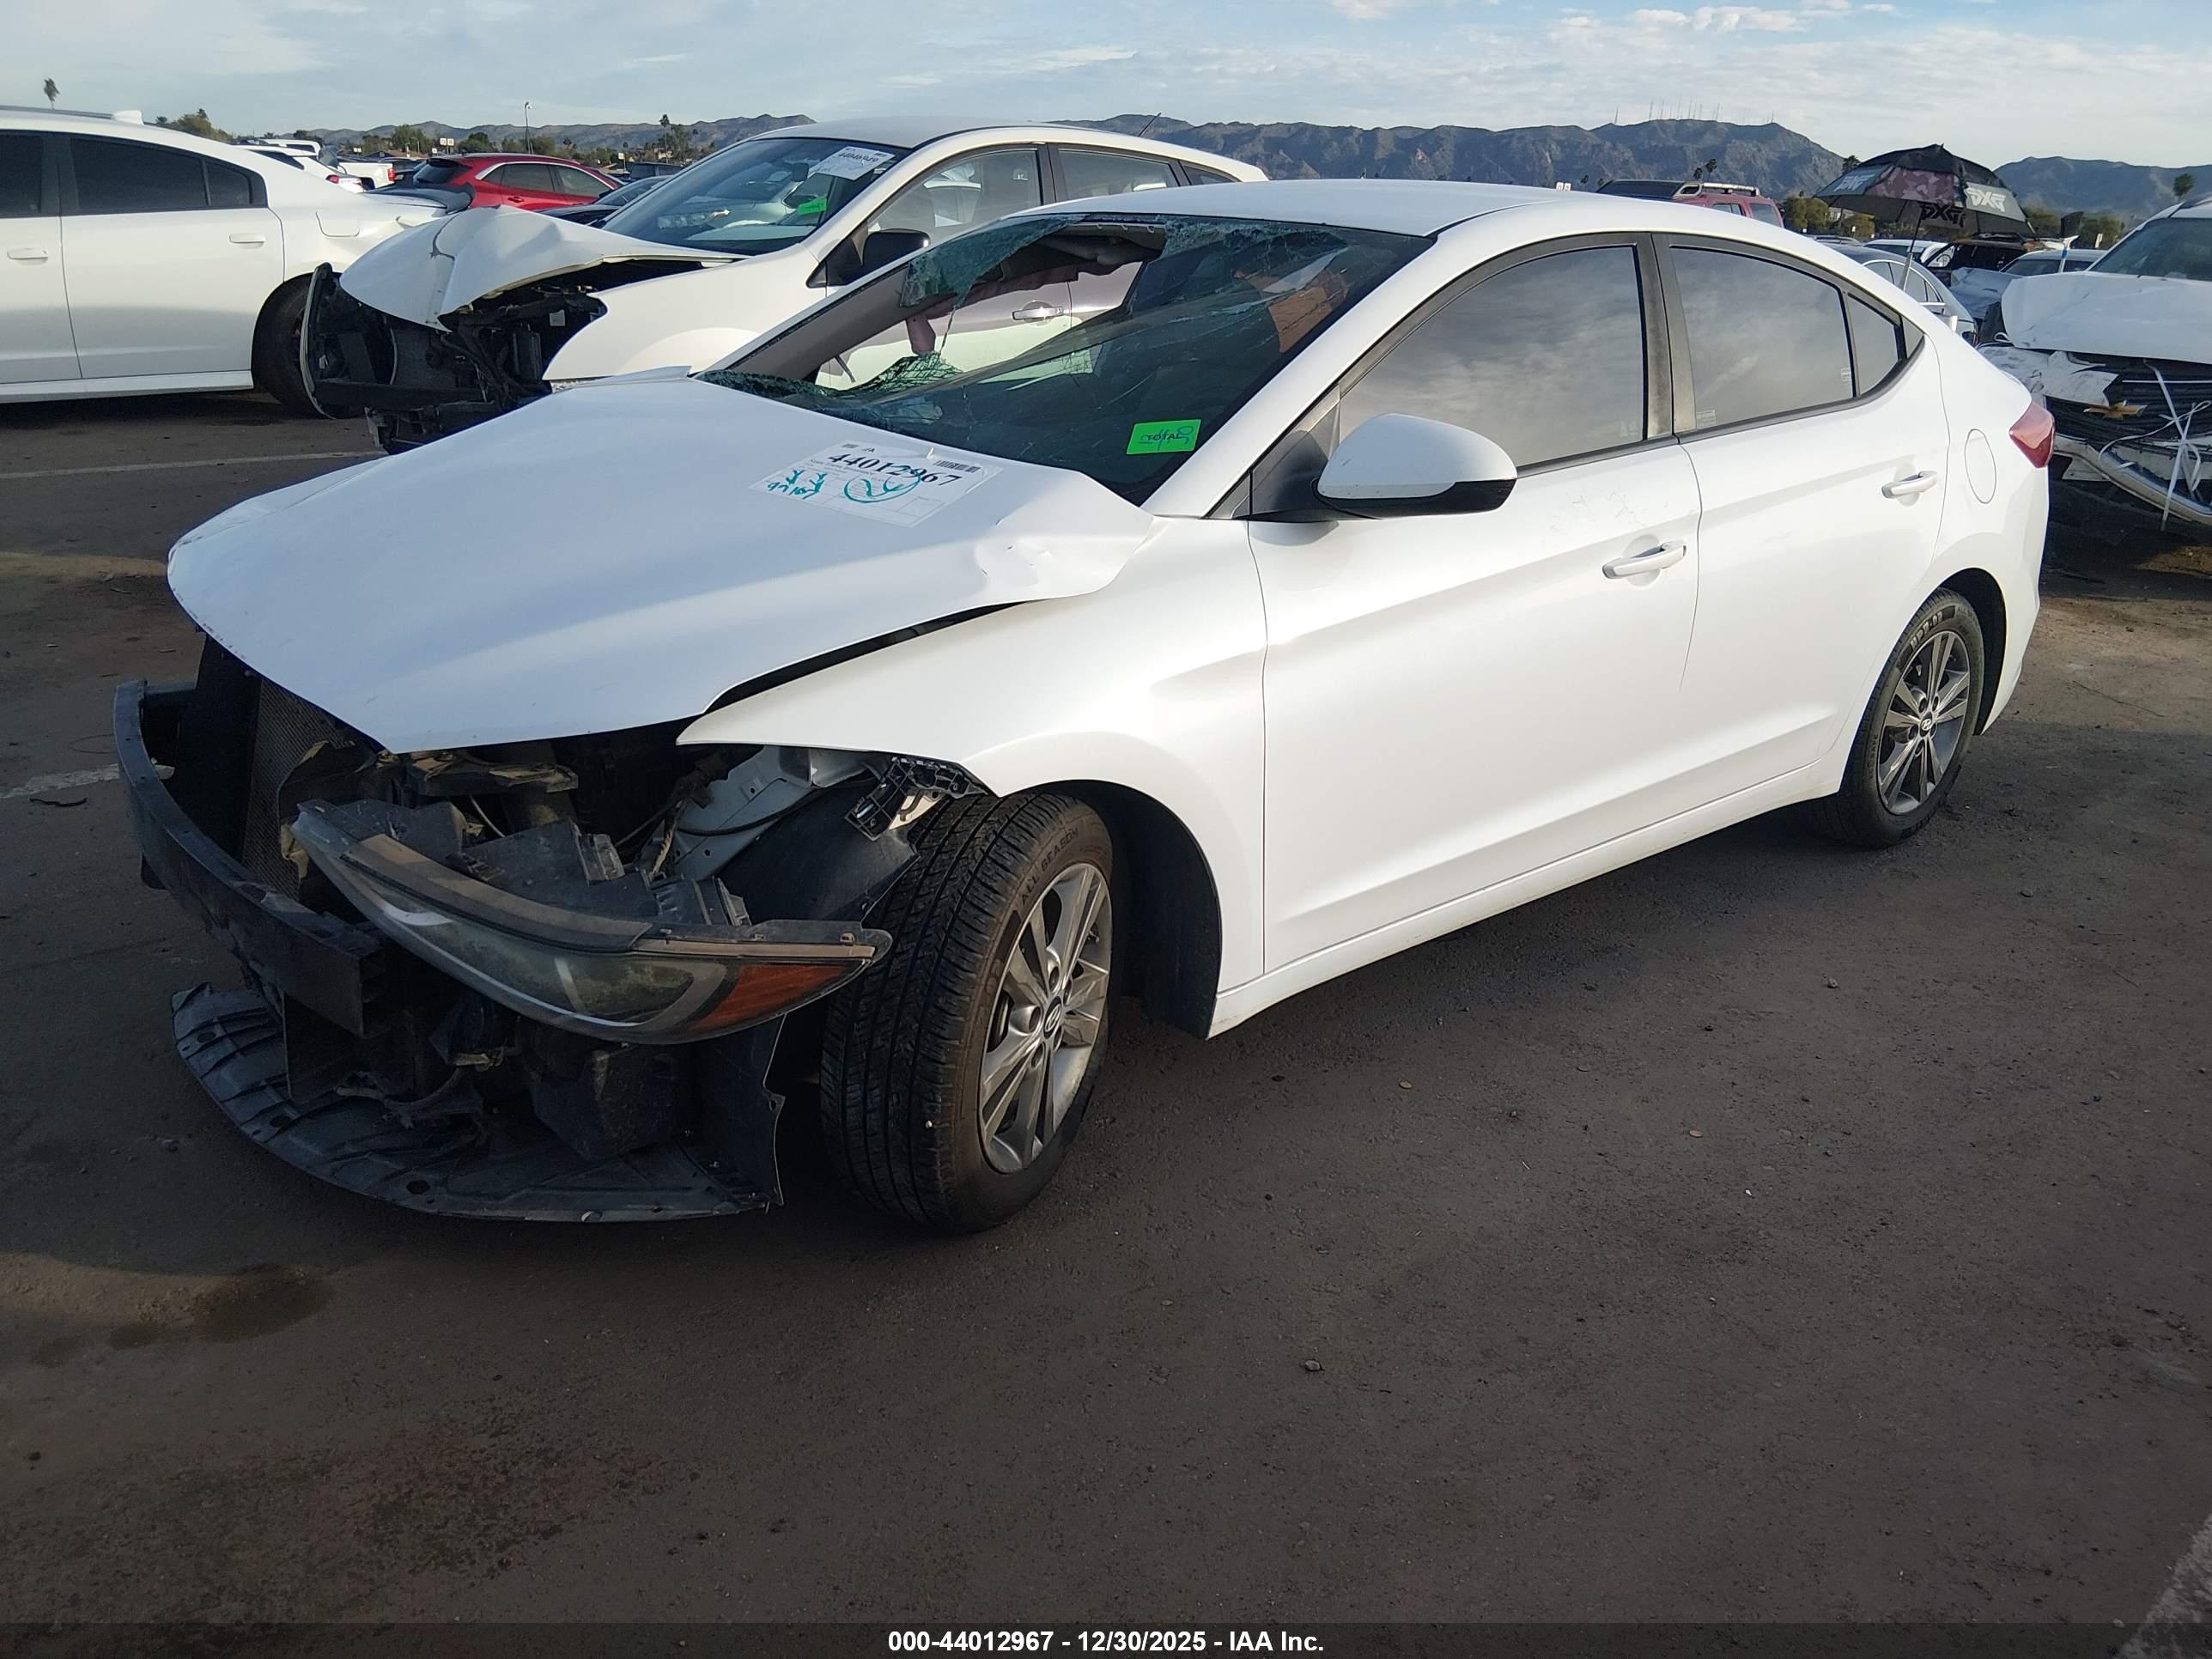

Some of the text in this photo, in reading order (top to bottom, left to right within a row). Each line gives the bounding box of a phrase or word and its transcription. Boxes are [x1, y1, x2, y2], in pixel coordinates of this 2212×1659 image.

[1964, 187, 2007, 213] PXG
[1146, 433, 1182, 441] TOTAL
[829, 453, 963, 486] 44012967
